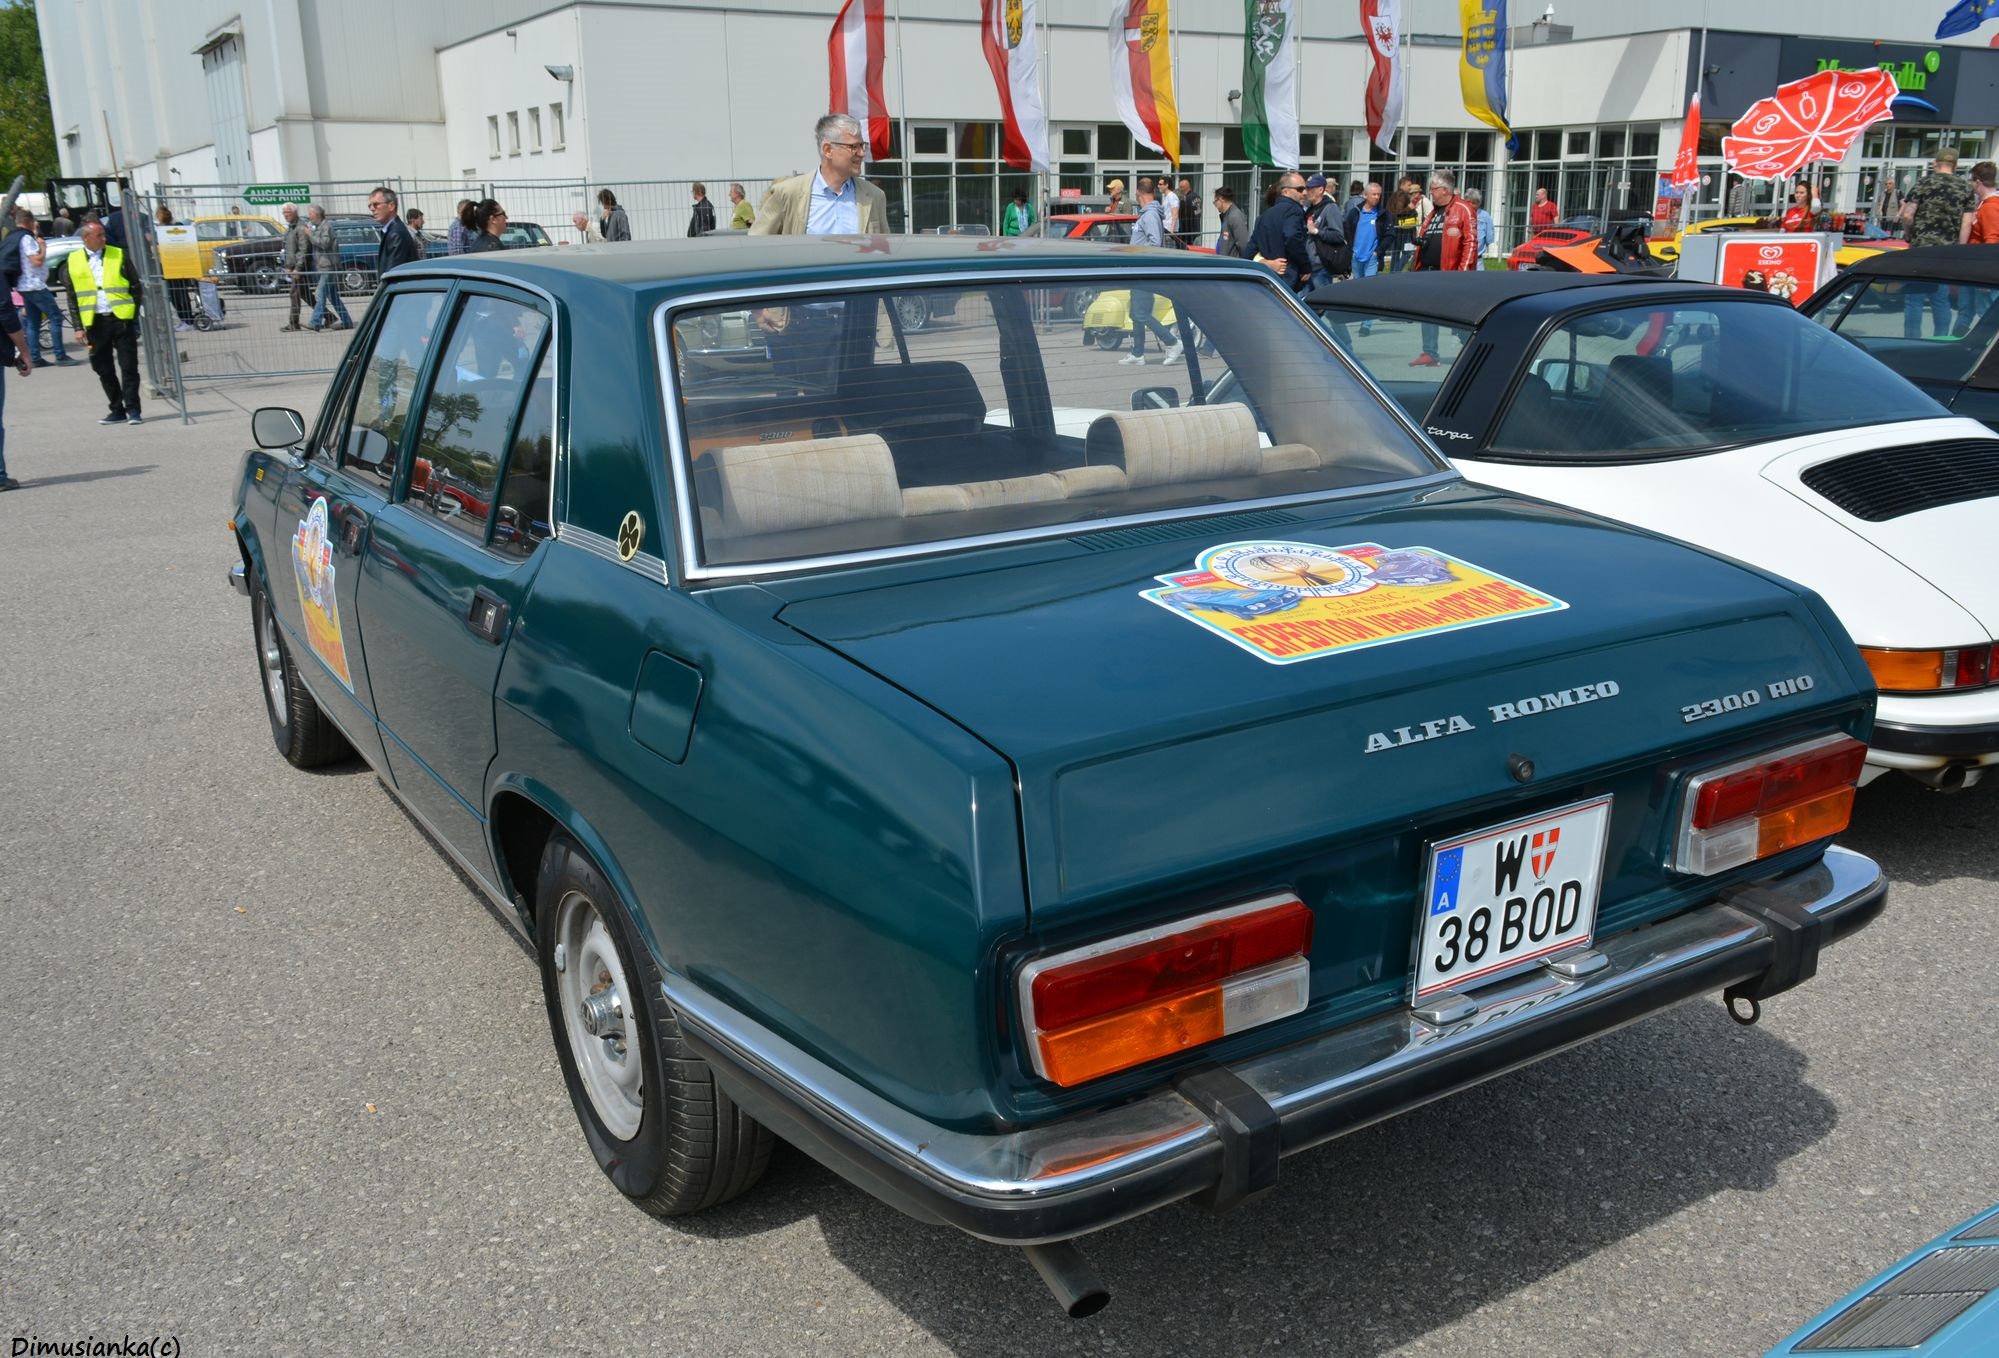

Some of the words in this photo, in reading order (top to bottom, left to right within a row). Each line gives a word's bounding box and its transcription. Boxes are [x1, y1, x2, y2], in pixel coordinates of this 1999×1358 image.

[249, 188, 307, 202] AUSFAHRT
[1810, 243, 1817, 252] 2
[1427, 426, 1474, 440] targa
[1323, 591, 1406, 611] CLASSIC
[1231, 618, 1382, 656] EXPEDITION
[1681, 689, 1761, 723] 2300
[1767, 674, 1814, 699] RIO
[1364, 714, 1476, 754] ALFA
[1488, 680, 1620, 723] ROMEO
[1495, 833, 1529, 897] W
[1437, 891, 1450, 911] A
[1434, 906, 1492, 973] 38
[1499, 879, 1582, 954] BOD
